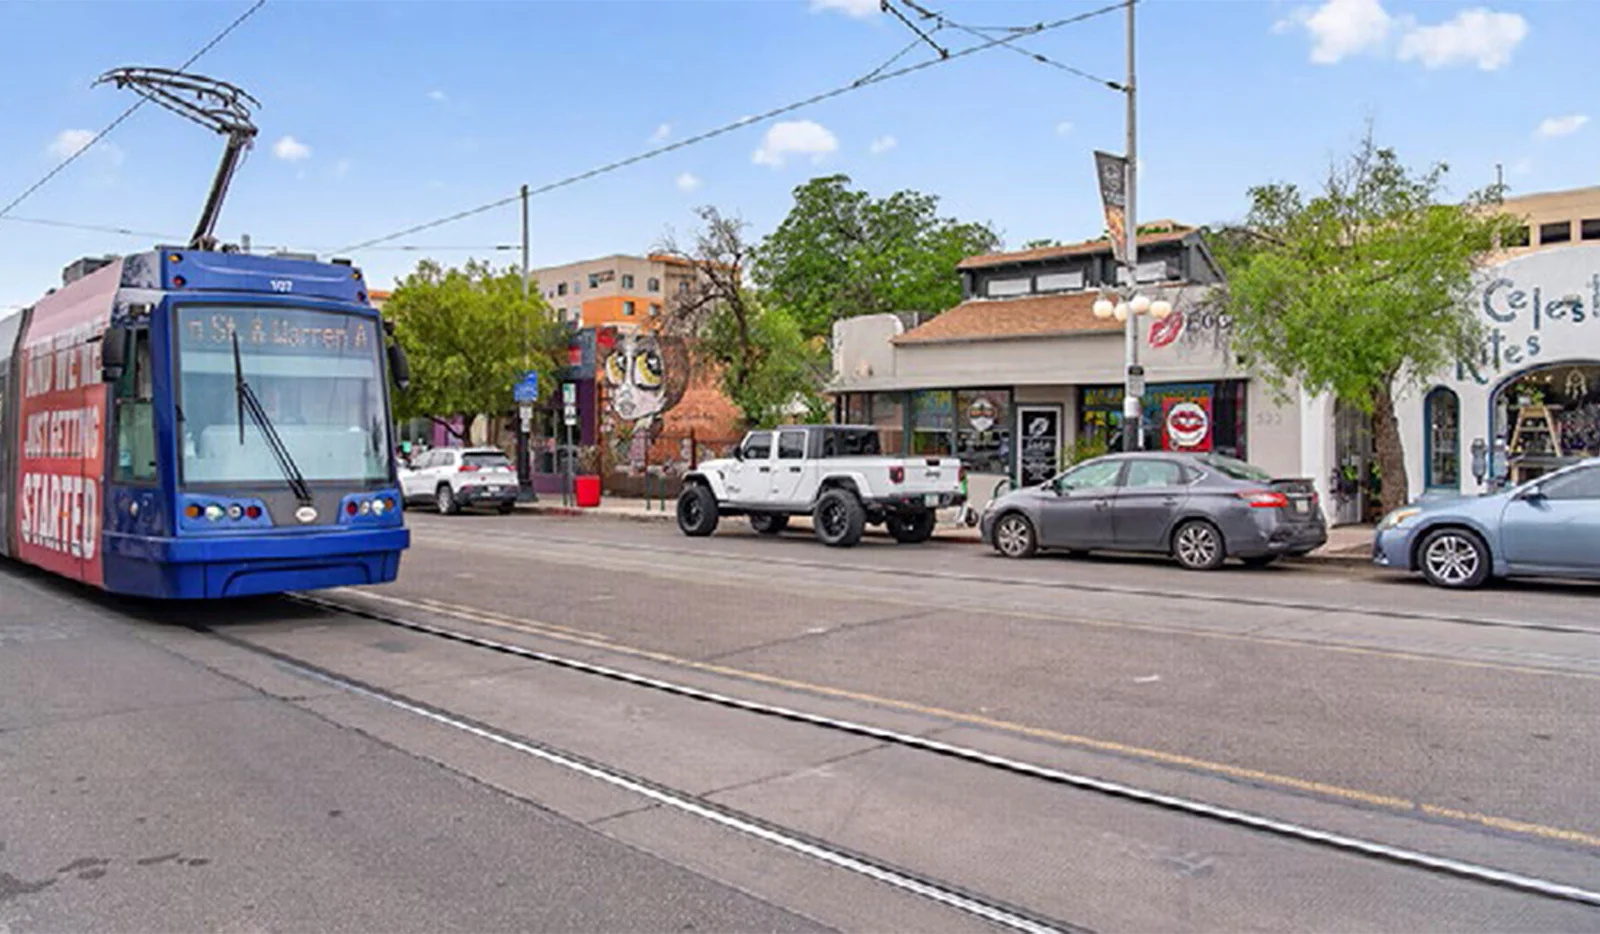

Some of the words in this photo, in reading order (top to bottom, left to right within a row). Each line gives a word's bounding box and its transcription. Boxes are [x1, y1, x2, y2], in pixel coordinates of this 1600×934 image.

[270, 280, 293, 293] 107
[272, 319, 349, 349] Warren
[24, 410, 49, 458] JUST
[51, 405, 99, 459] GETTING
[21, 473, 97, 560] STARTED
